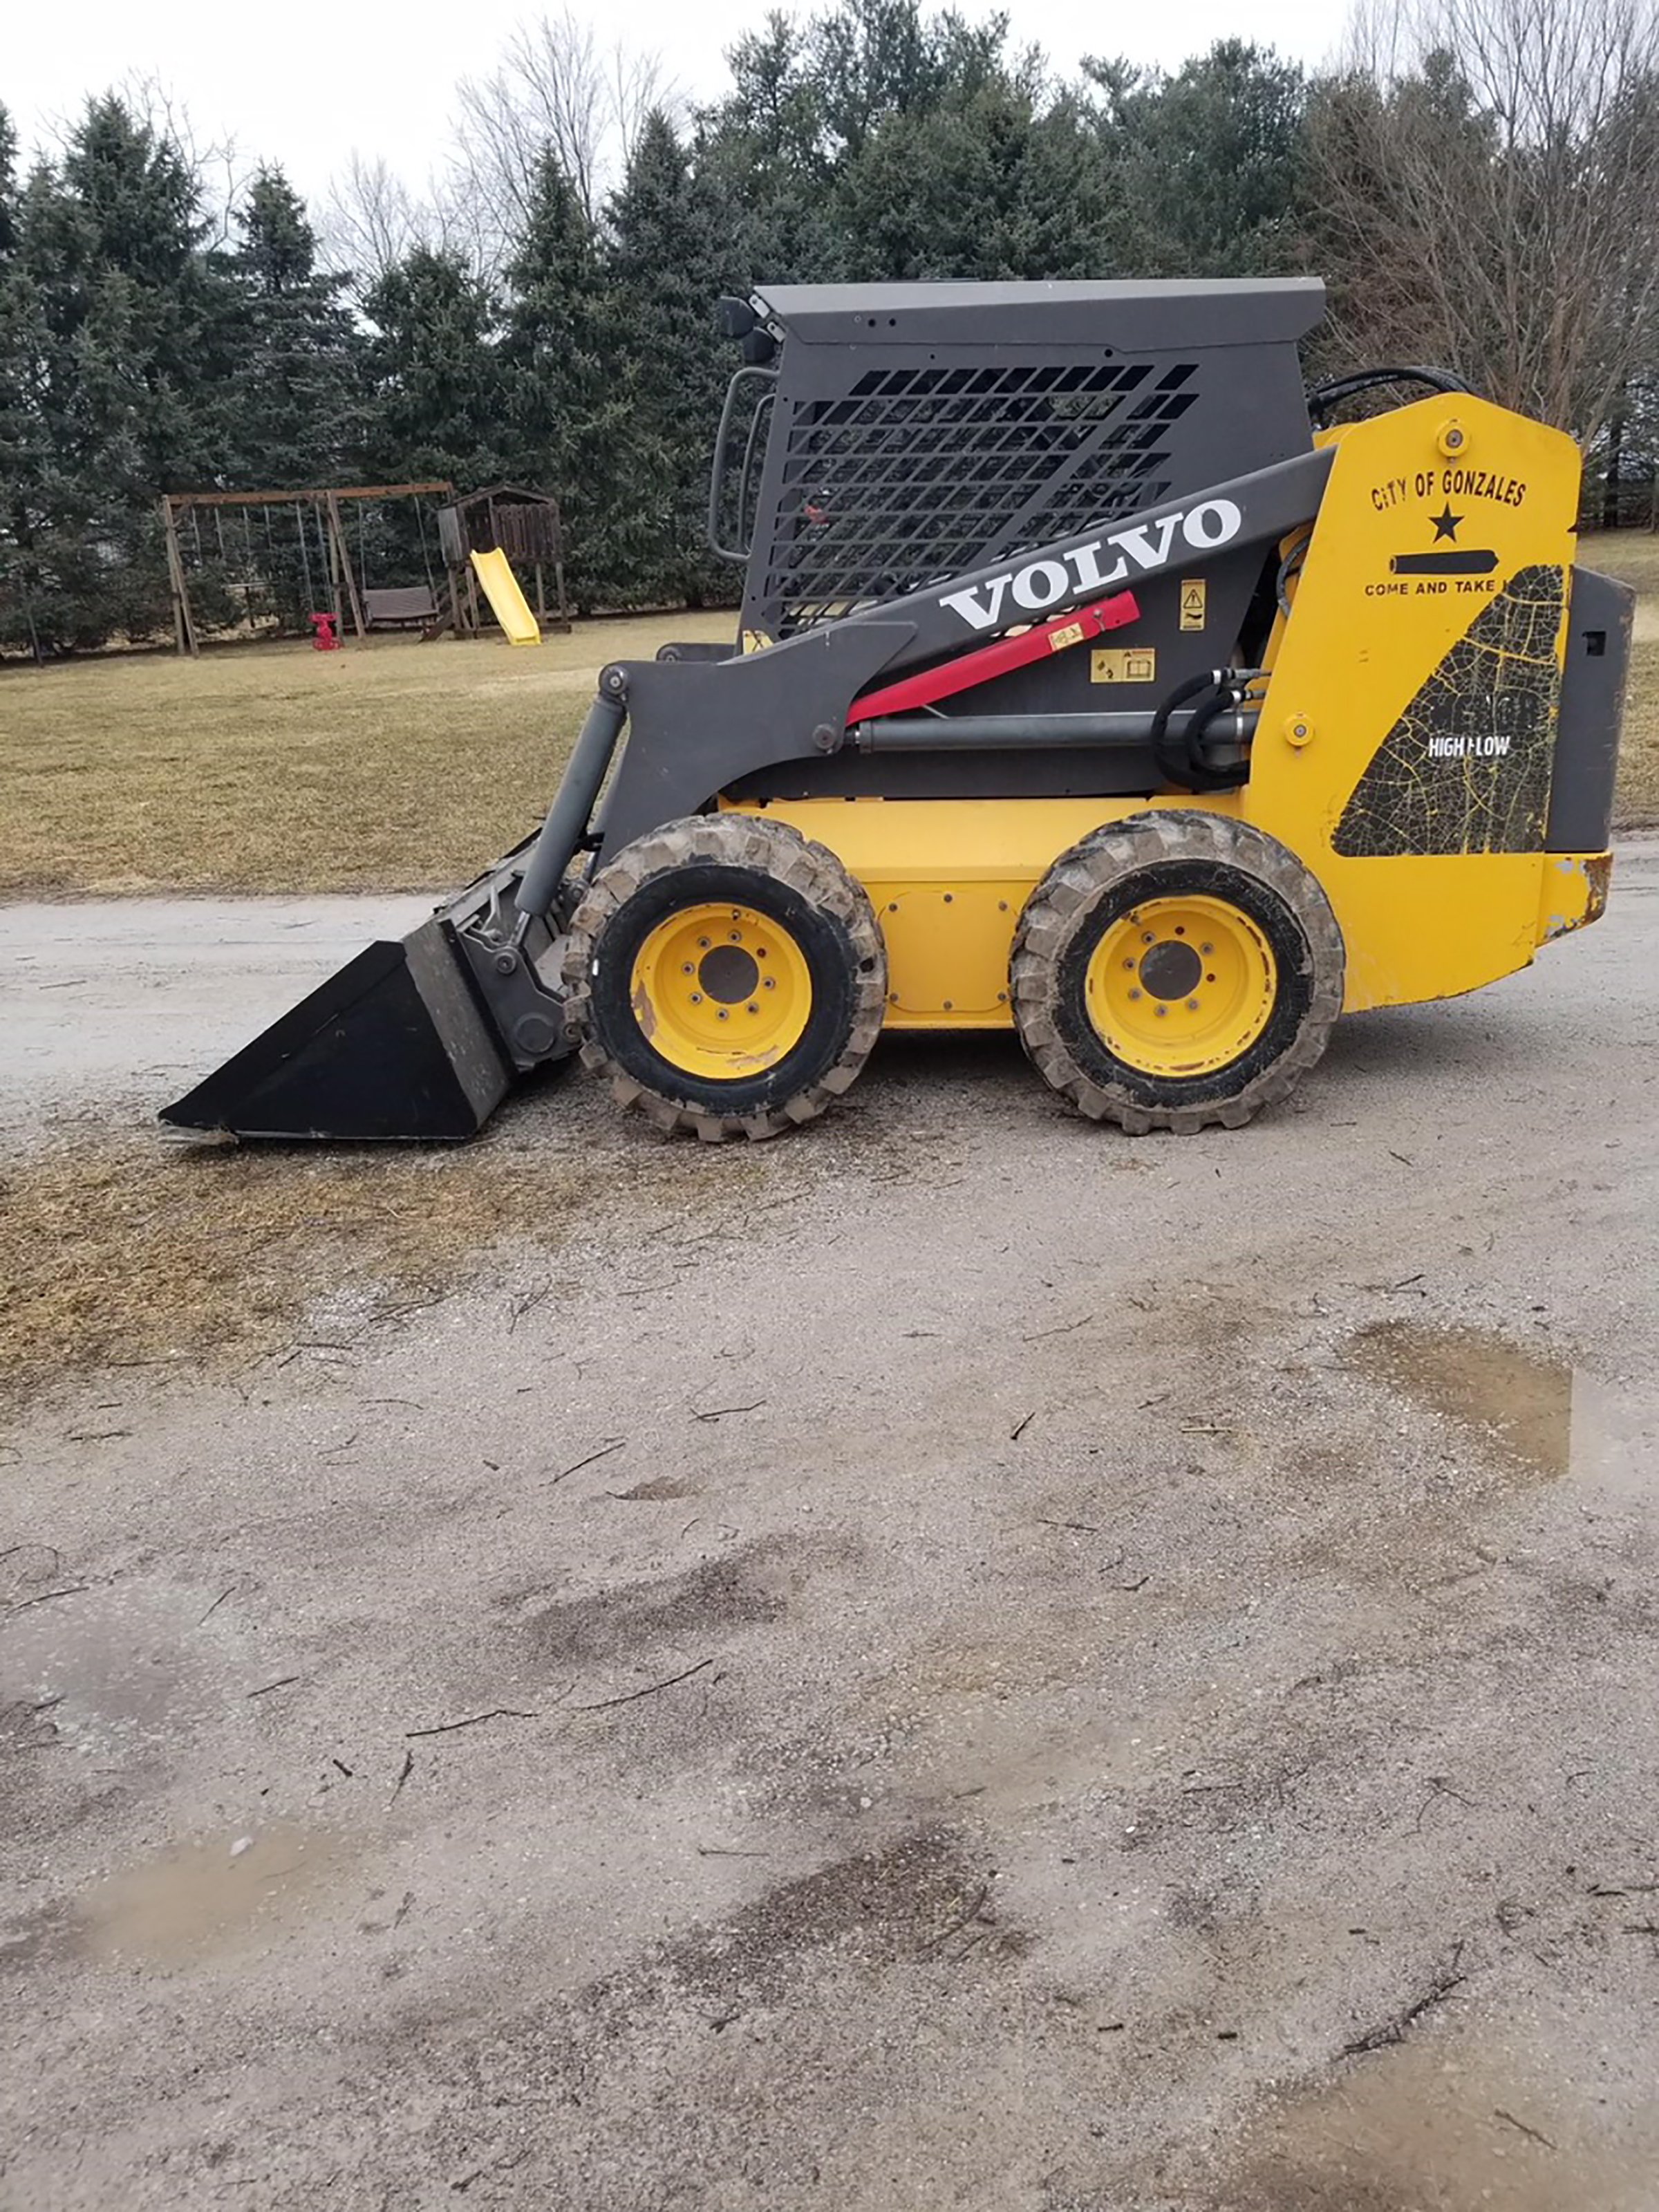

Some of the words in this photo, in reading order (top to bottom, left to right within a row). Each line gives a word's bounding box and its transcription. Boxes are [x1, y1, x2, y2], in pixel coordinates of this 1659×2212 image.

[1371, 477, 1406, 511] CITY
[1415, 471, 1434, 497] OF
[1442, 469, 1526, 507] GONZALES
[939, 499, 1241, 630] VOLVO
[1365, 583, 1409, 596] COME
[1416, 581, 1447, 594] AND
[1455, 579, 1495, 593] TAKE
[1428, 737, 1465, 758] HIGH
